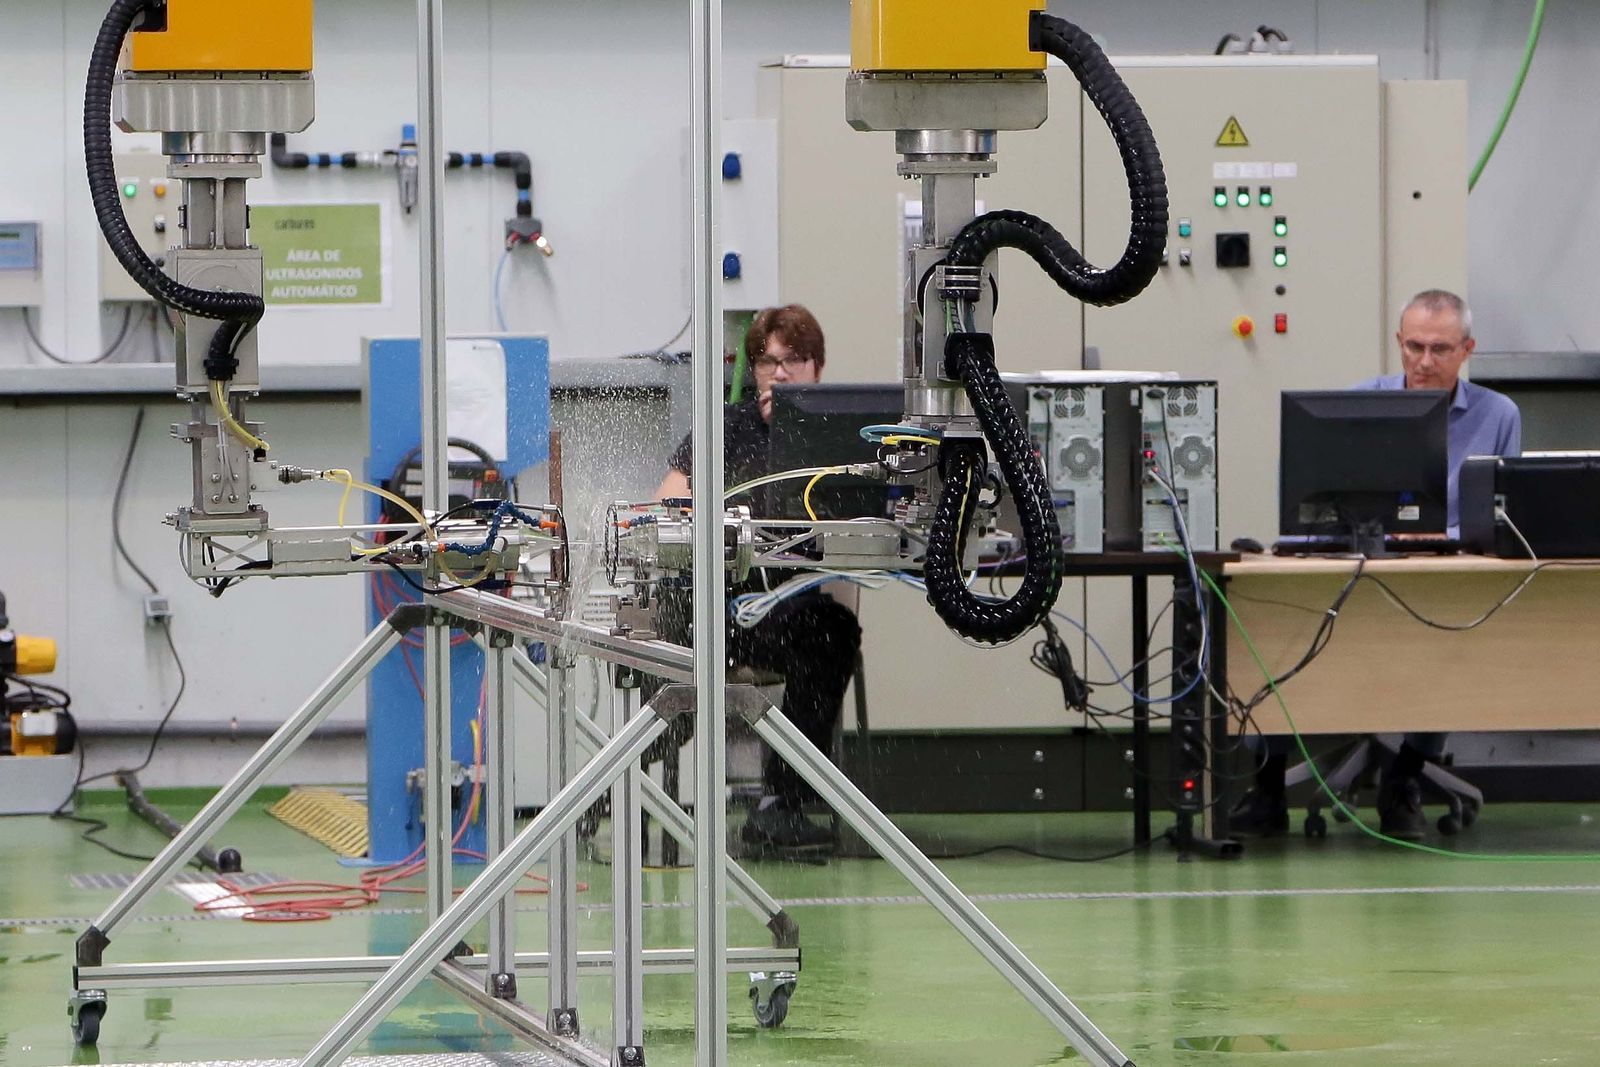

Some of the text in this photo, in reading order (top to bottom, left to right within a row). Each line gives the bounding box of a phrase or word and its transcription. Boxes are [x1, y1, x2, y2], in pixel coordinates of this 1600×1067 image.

[286, 249, 340, 262] ÁREA DE
[266, 267, 363, 280] ULTRASONIDOS
[271, 284, 357, 298] AUTOMÁTICO
